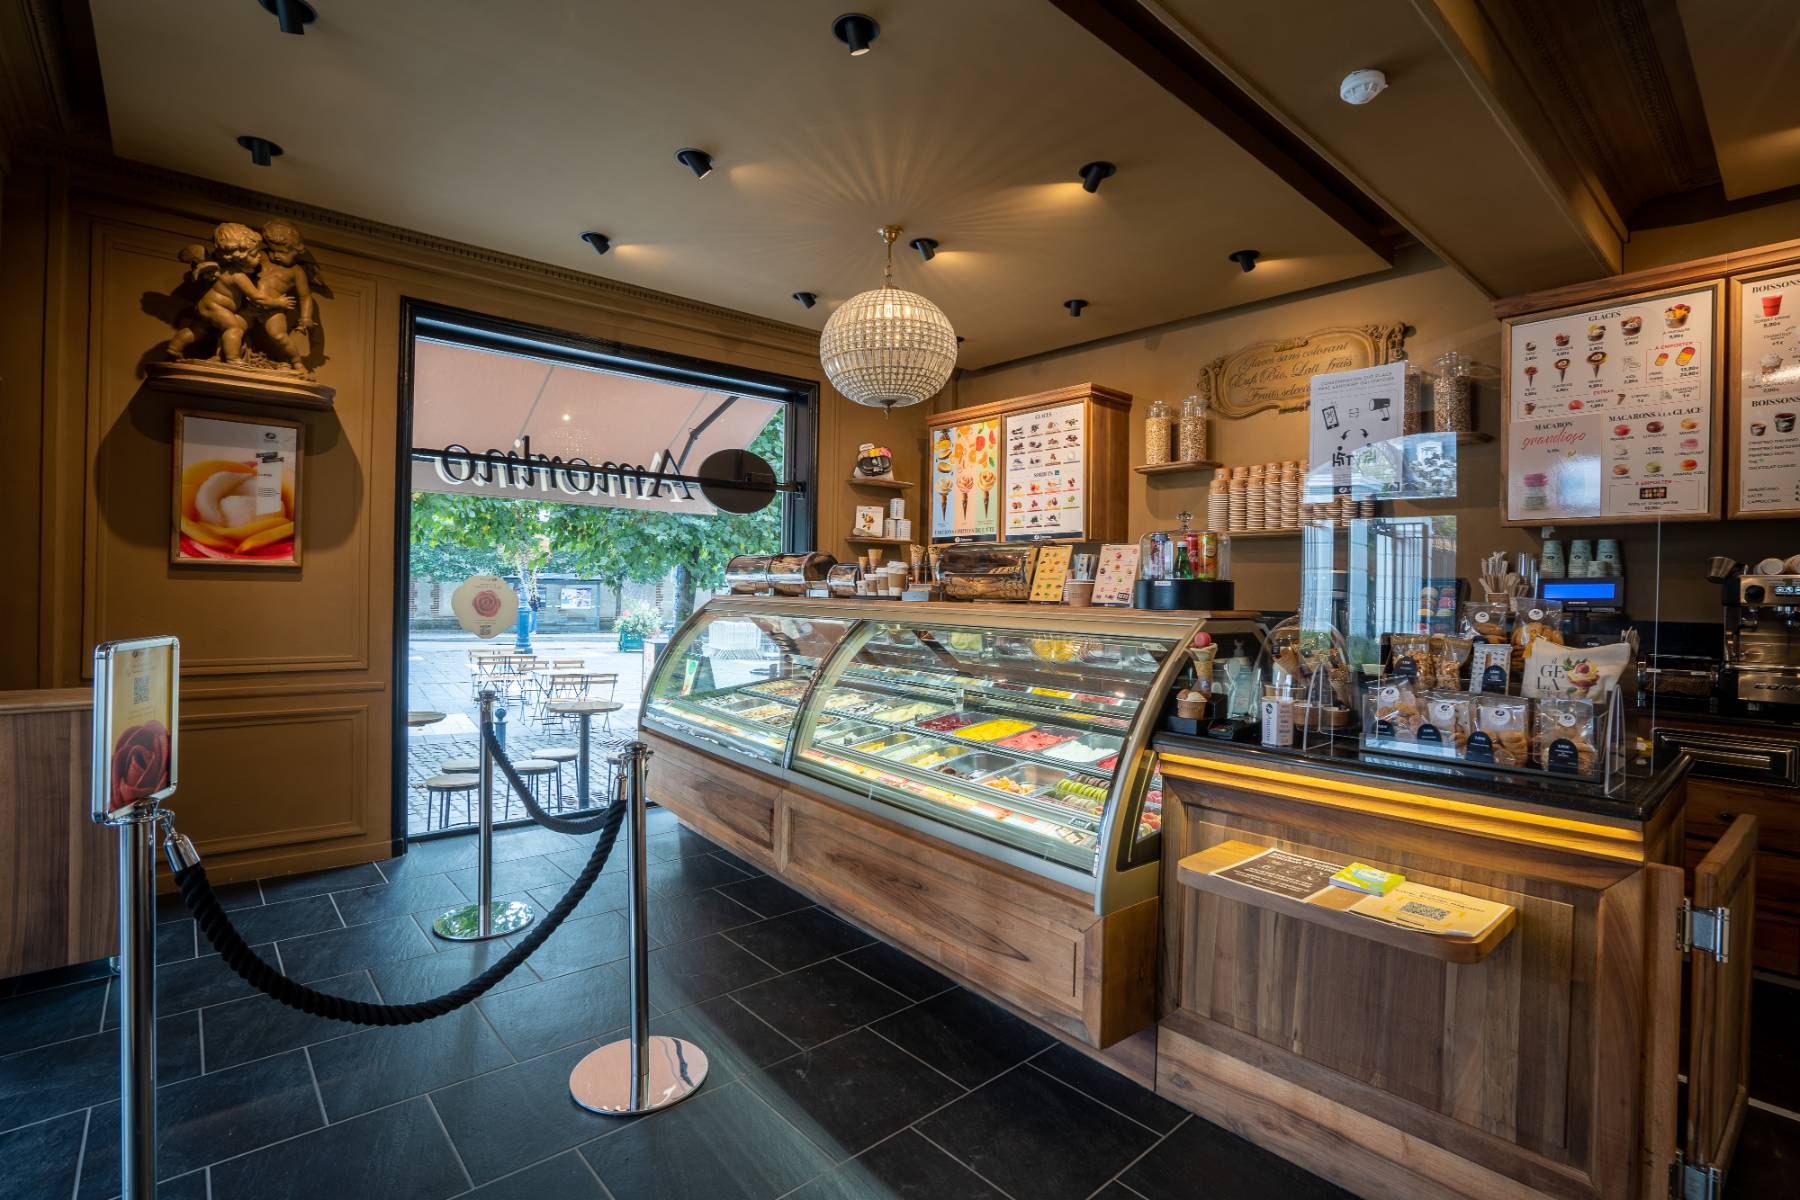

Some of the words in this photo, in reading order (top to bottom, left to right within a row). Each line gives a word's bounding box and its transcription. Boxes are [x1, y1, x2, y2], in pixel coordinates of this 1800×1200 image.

[1588, 311, 1621, 321] GLACES
[1302, 342, 1349, 357] colorant
[1608, 412, 1656, 422] MACARONS
[1672, 407, 1704, 416] GLACE
[1535, 421, 1573, 430] MACARON
